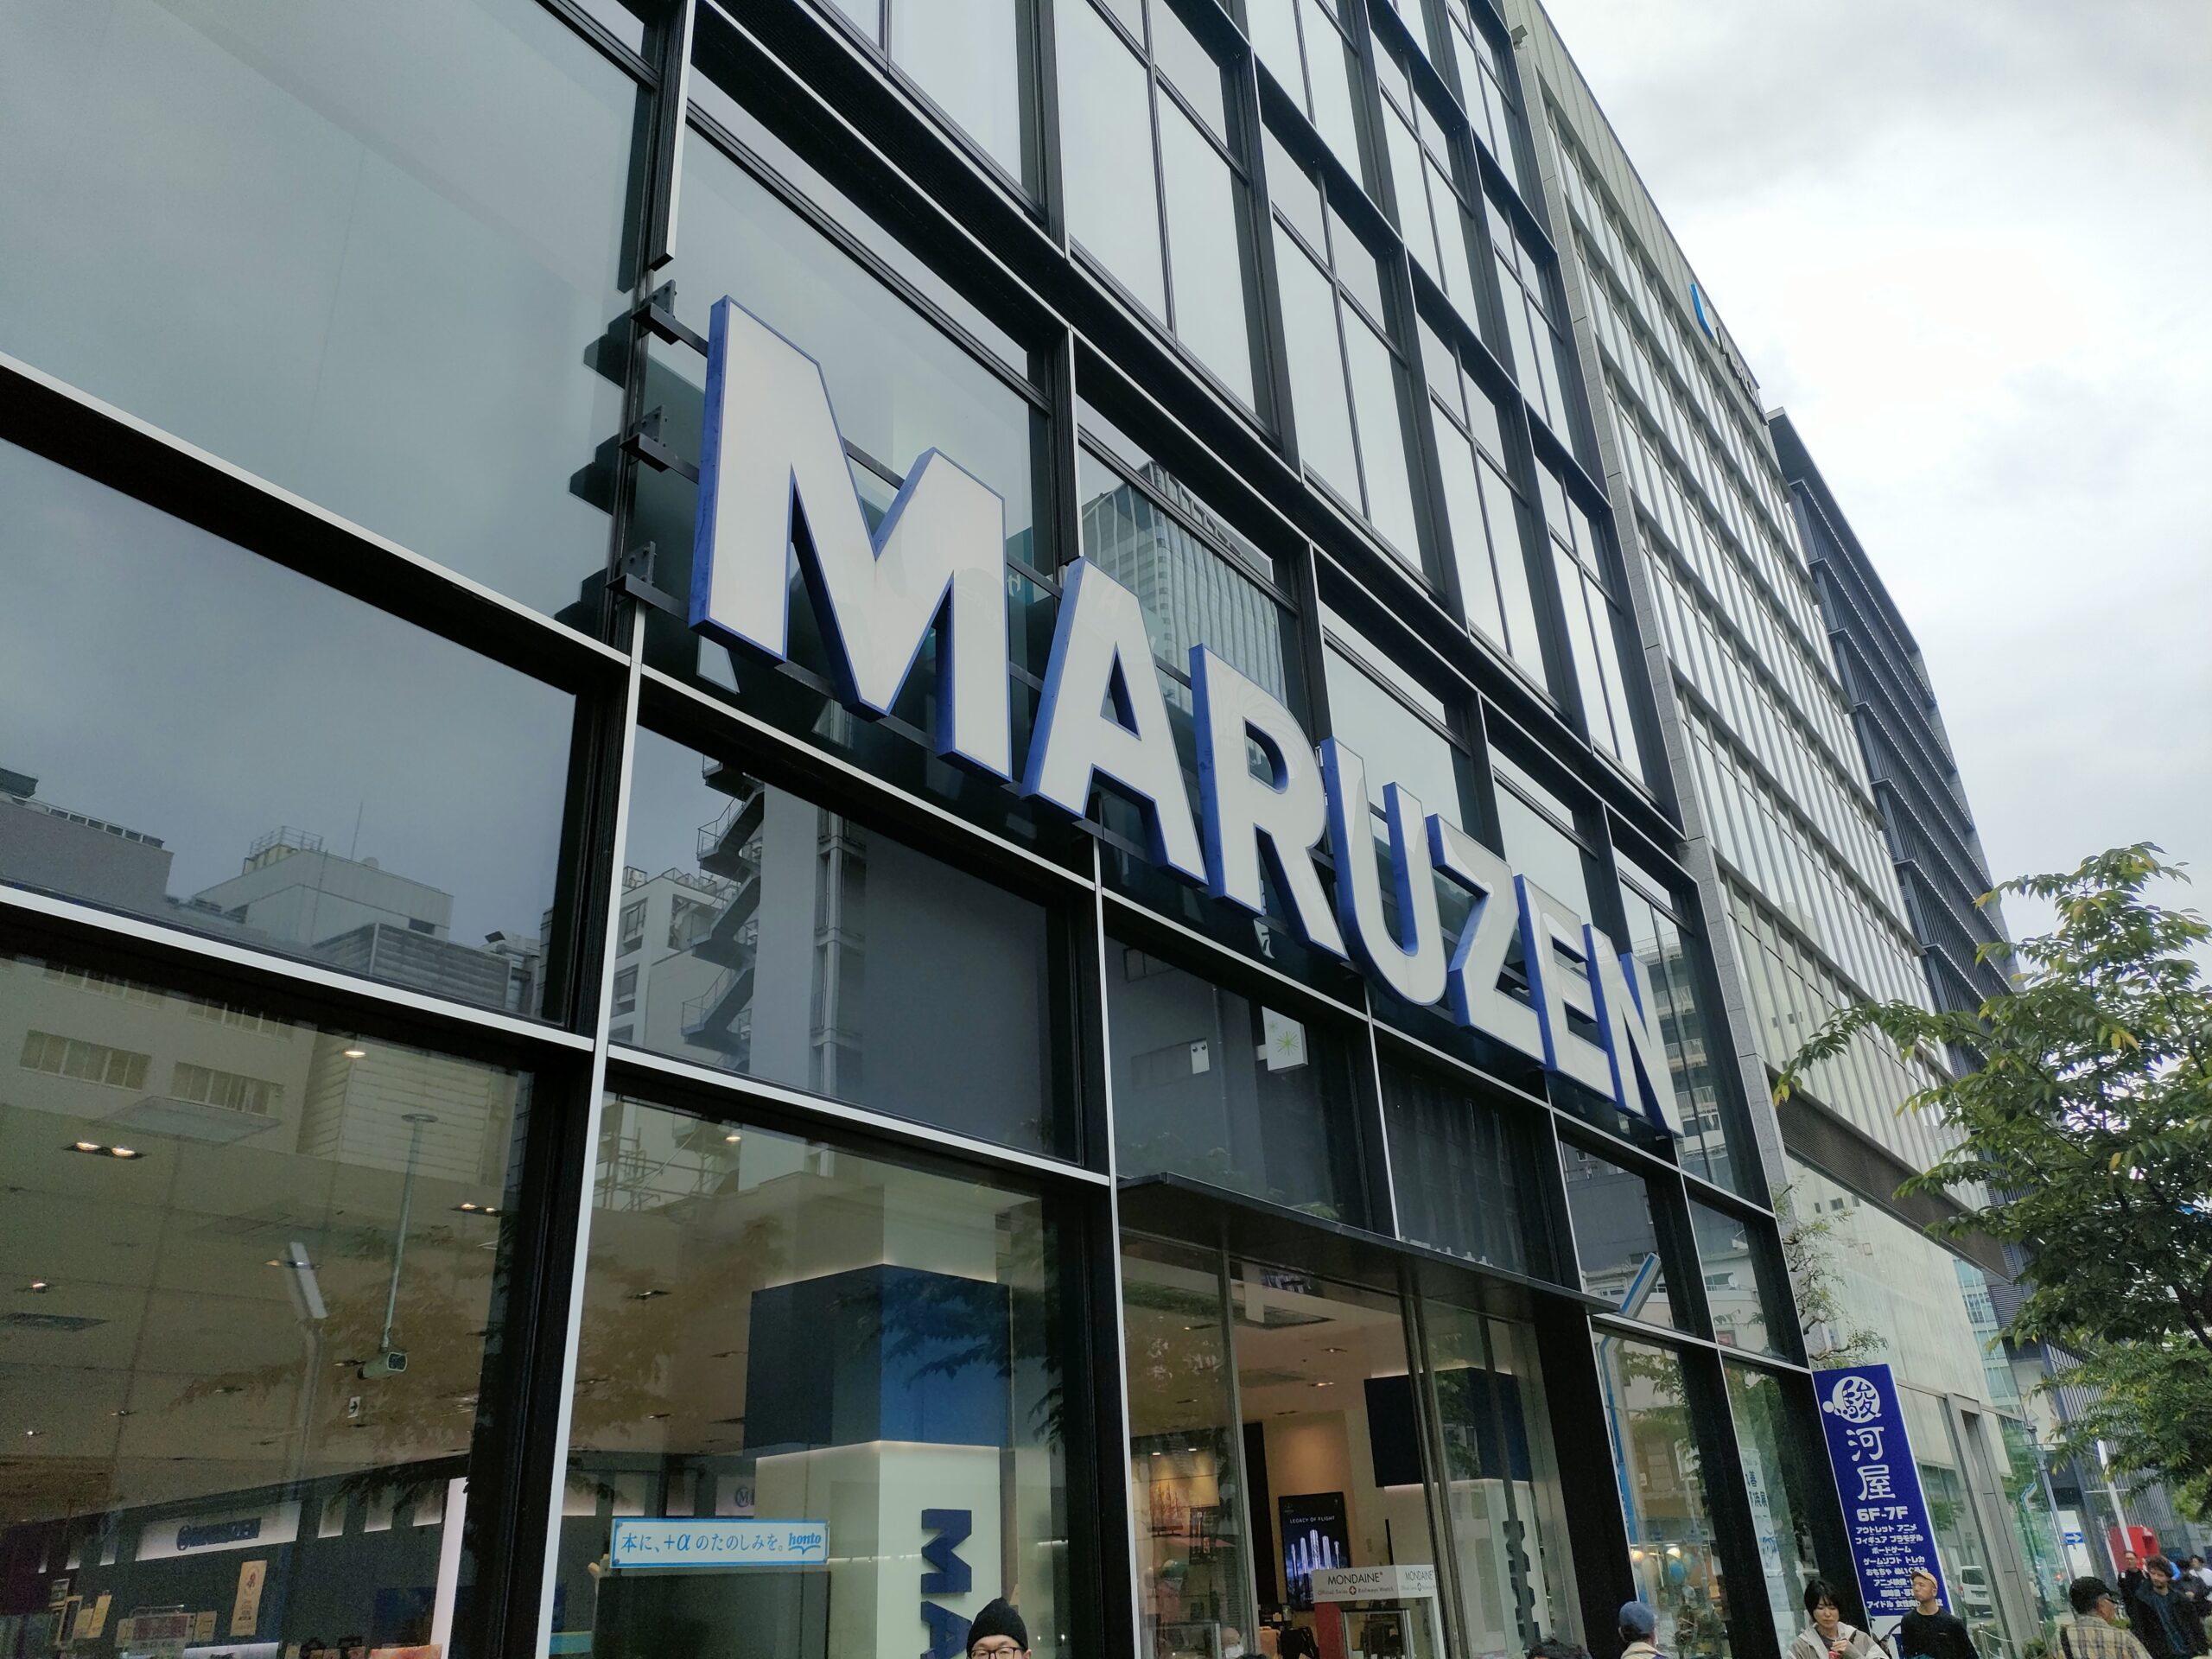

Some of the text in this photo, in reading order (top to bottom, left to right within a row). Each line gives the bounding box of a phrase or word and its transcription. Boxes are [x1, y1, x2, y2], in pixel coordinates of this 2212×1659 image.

[689, 295, 1685, 1137] MARUZEN
[1831, 1376, 1896, 1501] 駿河屋
[1856, 1506, 1908, 1522] 6F-7F
[788, 1532, 822, 1547] honto
[1872, 1546, 1911, 1554] ボードゲーム
[1863, 1555, 1925, 1566] ゲームソフト トレカ
[1866, 1600, 1893, 1609] アイドル
